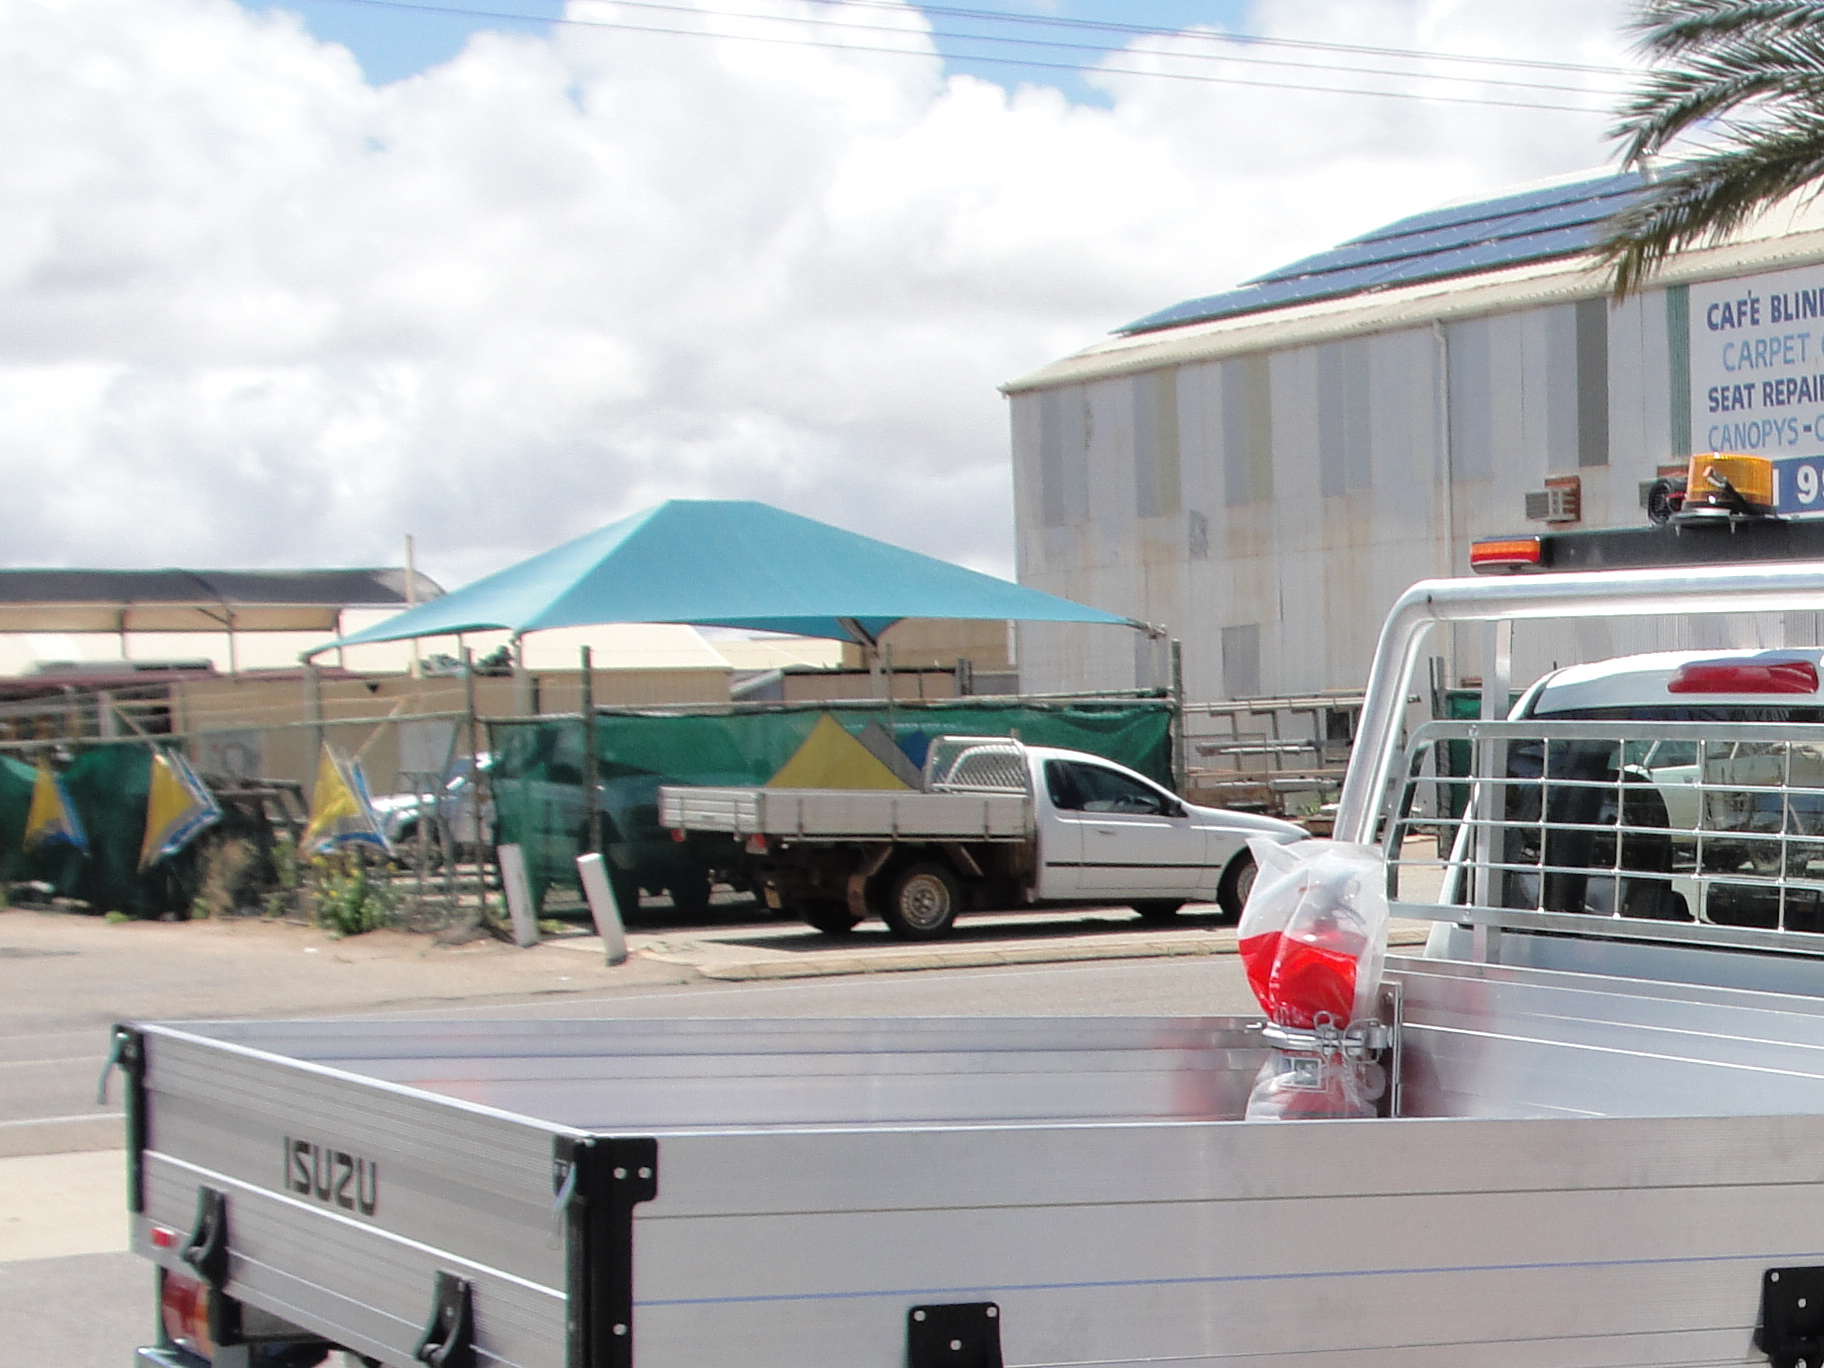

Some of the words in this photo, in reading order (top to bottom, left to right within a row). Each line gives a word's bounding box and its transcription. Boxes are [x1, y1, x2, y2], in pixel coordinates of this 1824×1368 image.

[1723, 332, 1810, 372] CARPET
[1708, 384, 1755, 413] SEAT
[283, 1136, 377, 1217] ISUZU
